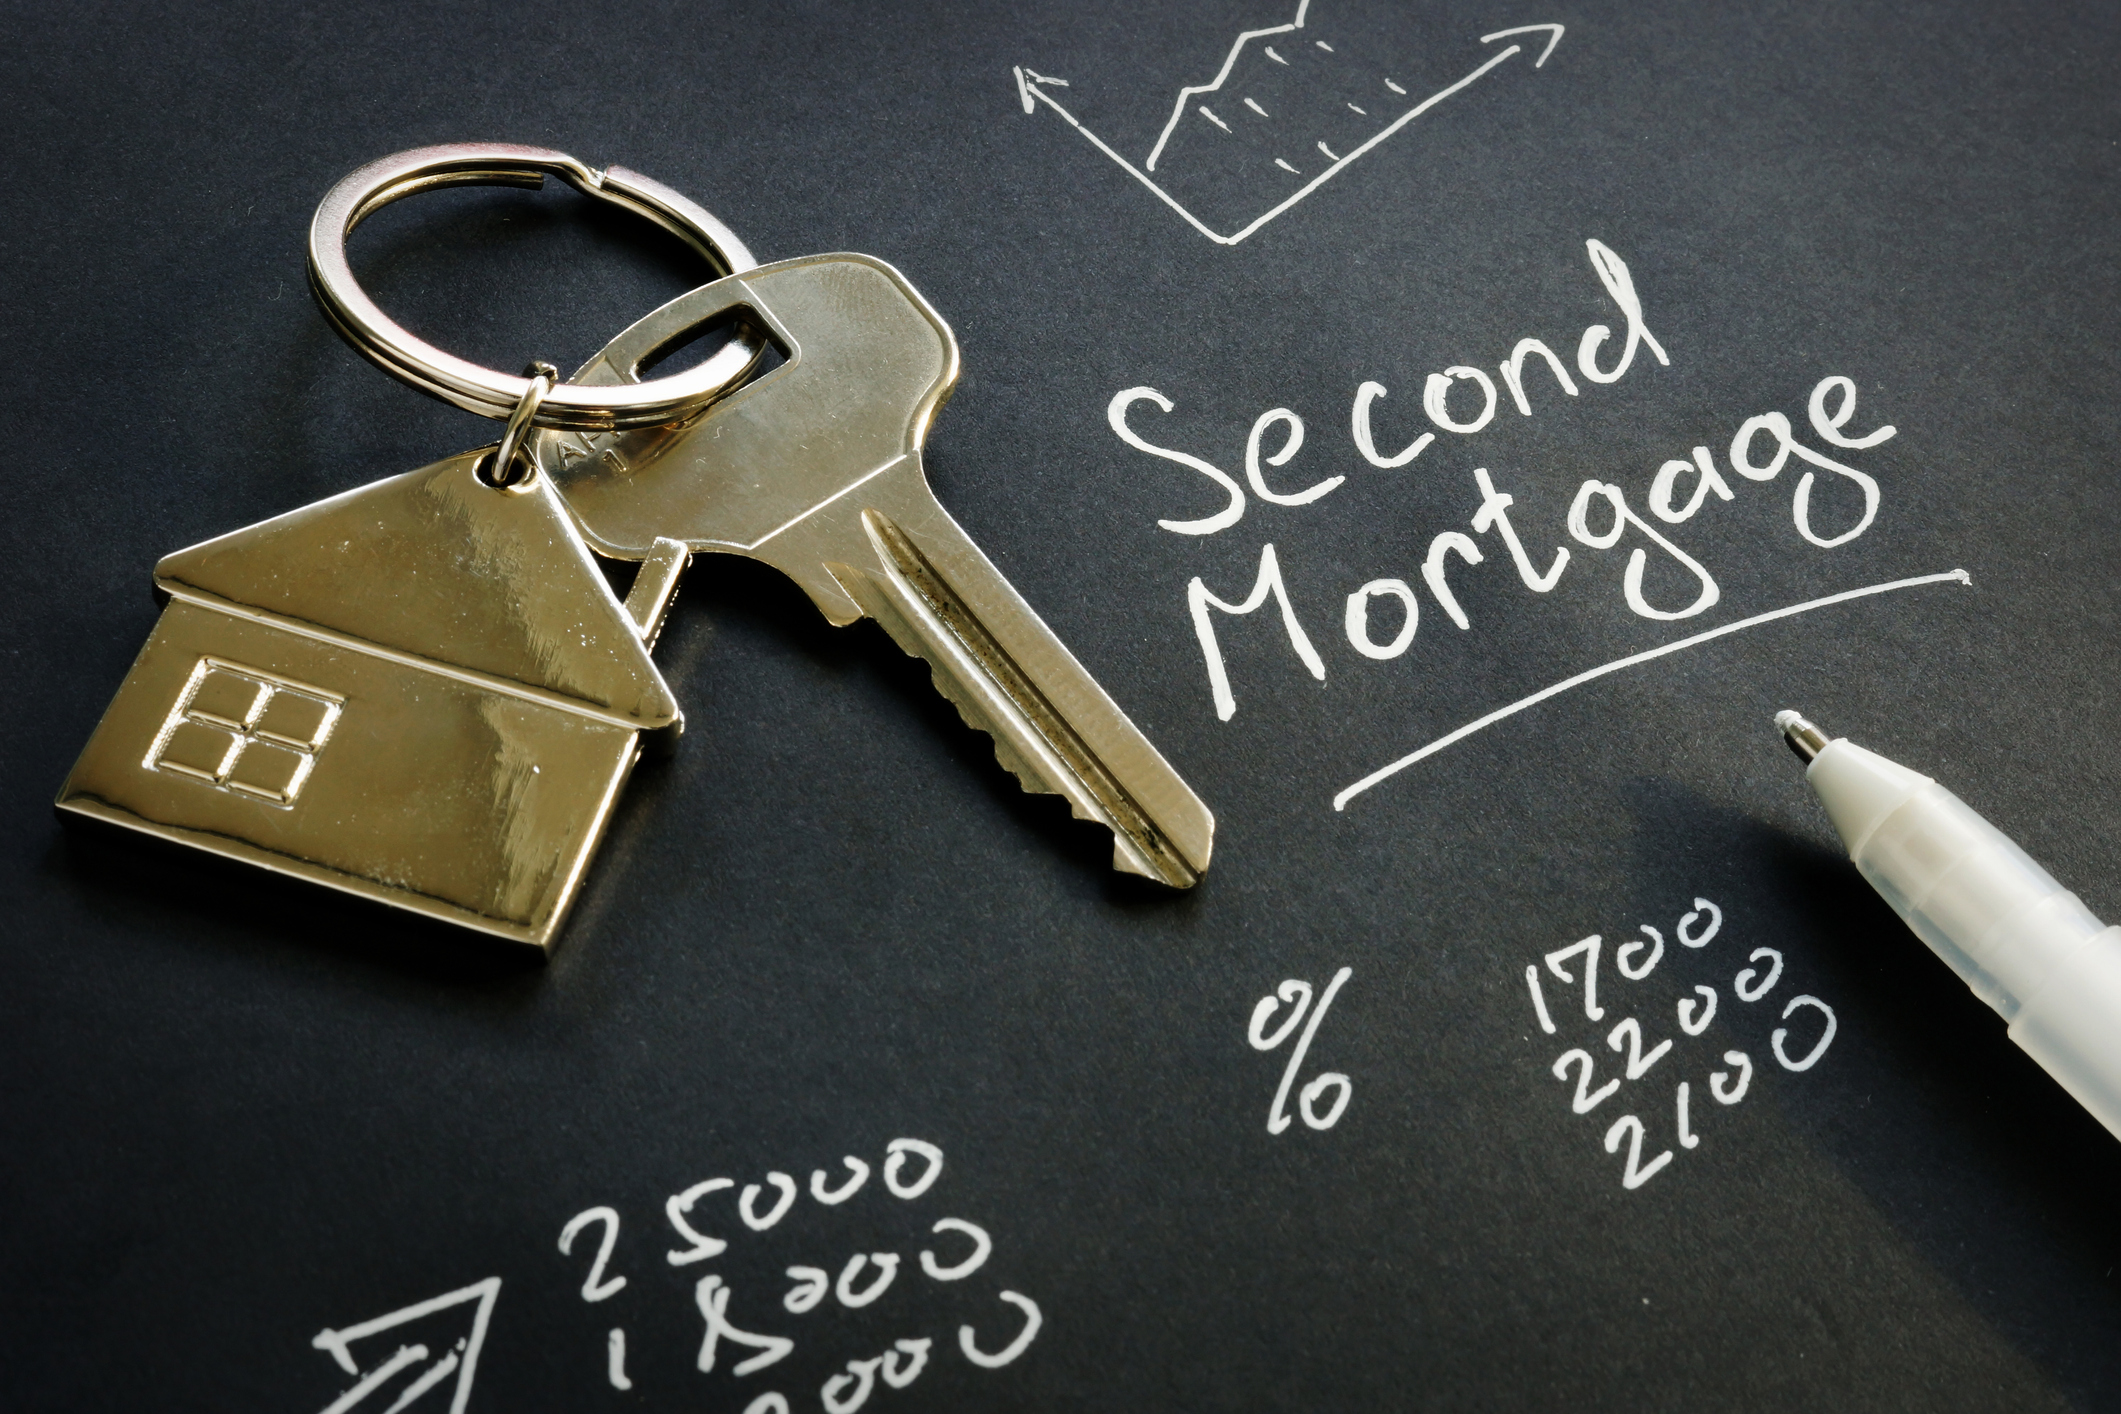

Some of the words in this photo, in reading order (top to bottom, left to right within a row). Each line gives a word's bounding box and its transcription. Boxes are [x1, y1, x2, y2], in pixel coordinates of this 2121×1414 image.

[1106, 238, 1671, 537] Second
[1187, 376, 1898, 722] Mortgage
[1247, 966, 1353, 1136] %
[1525, 897, 1723, 1035] 1700
[1551, 947, 1784, 1115] 2200
[1603, 994, 1837, 1190] 2100
